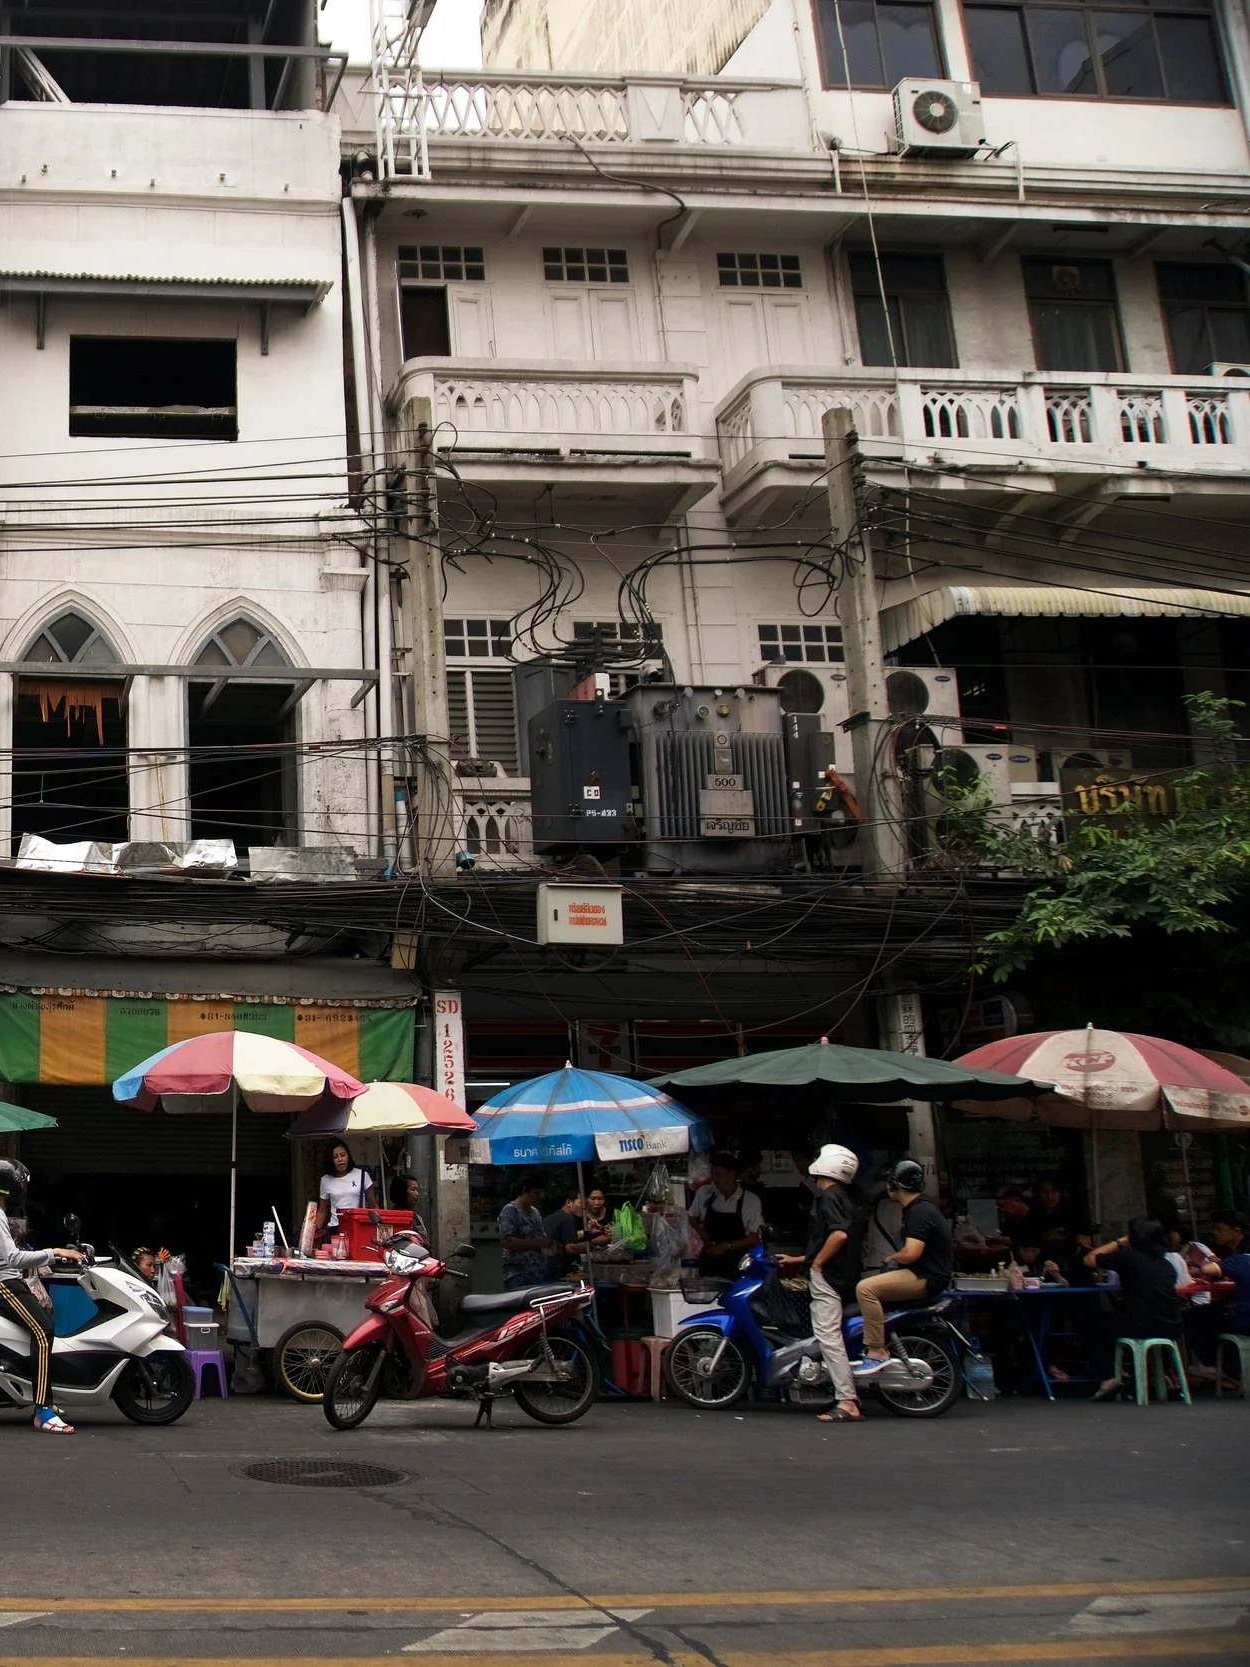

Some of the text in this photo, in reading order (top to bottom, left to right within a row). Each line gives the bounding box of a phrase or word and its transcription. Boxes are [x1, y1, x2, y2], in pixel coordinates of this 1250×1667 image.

[714, 778, 736, 787] 500
[436, 1000, 459, 1014] SD
[618, 1137, 668, 1153] TISCO Bank
